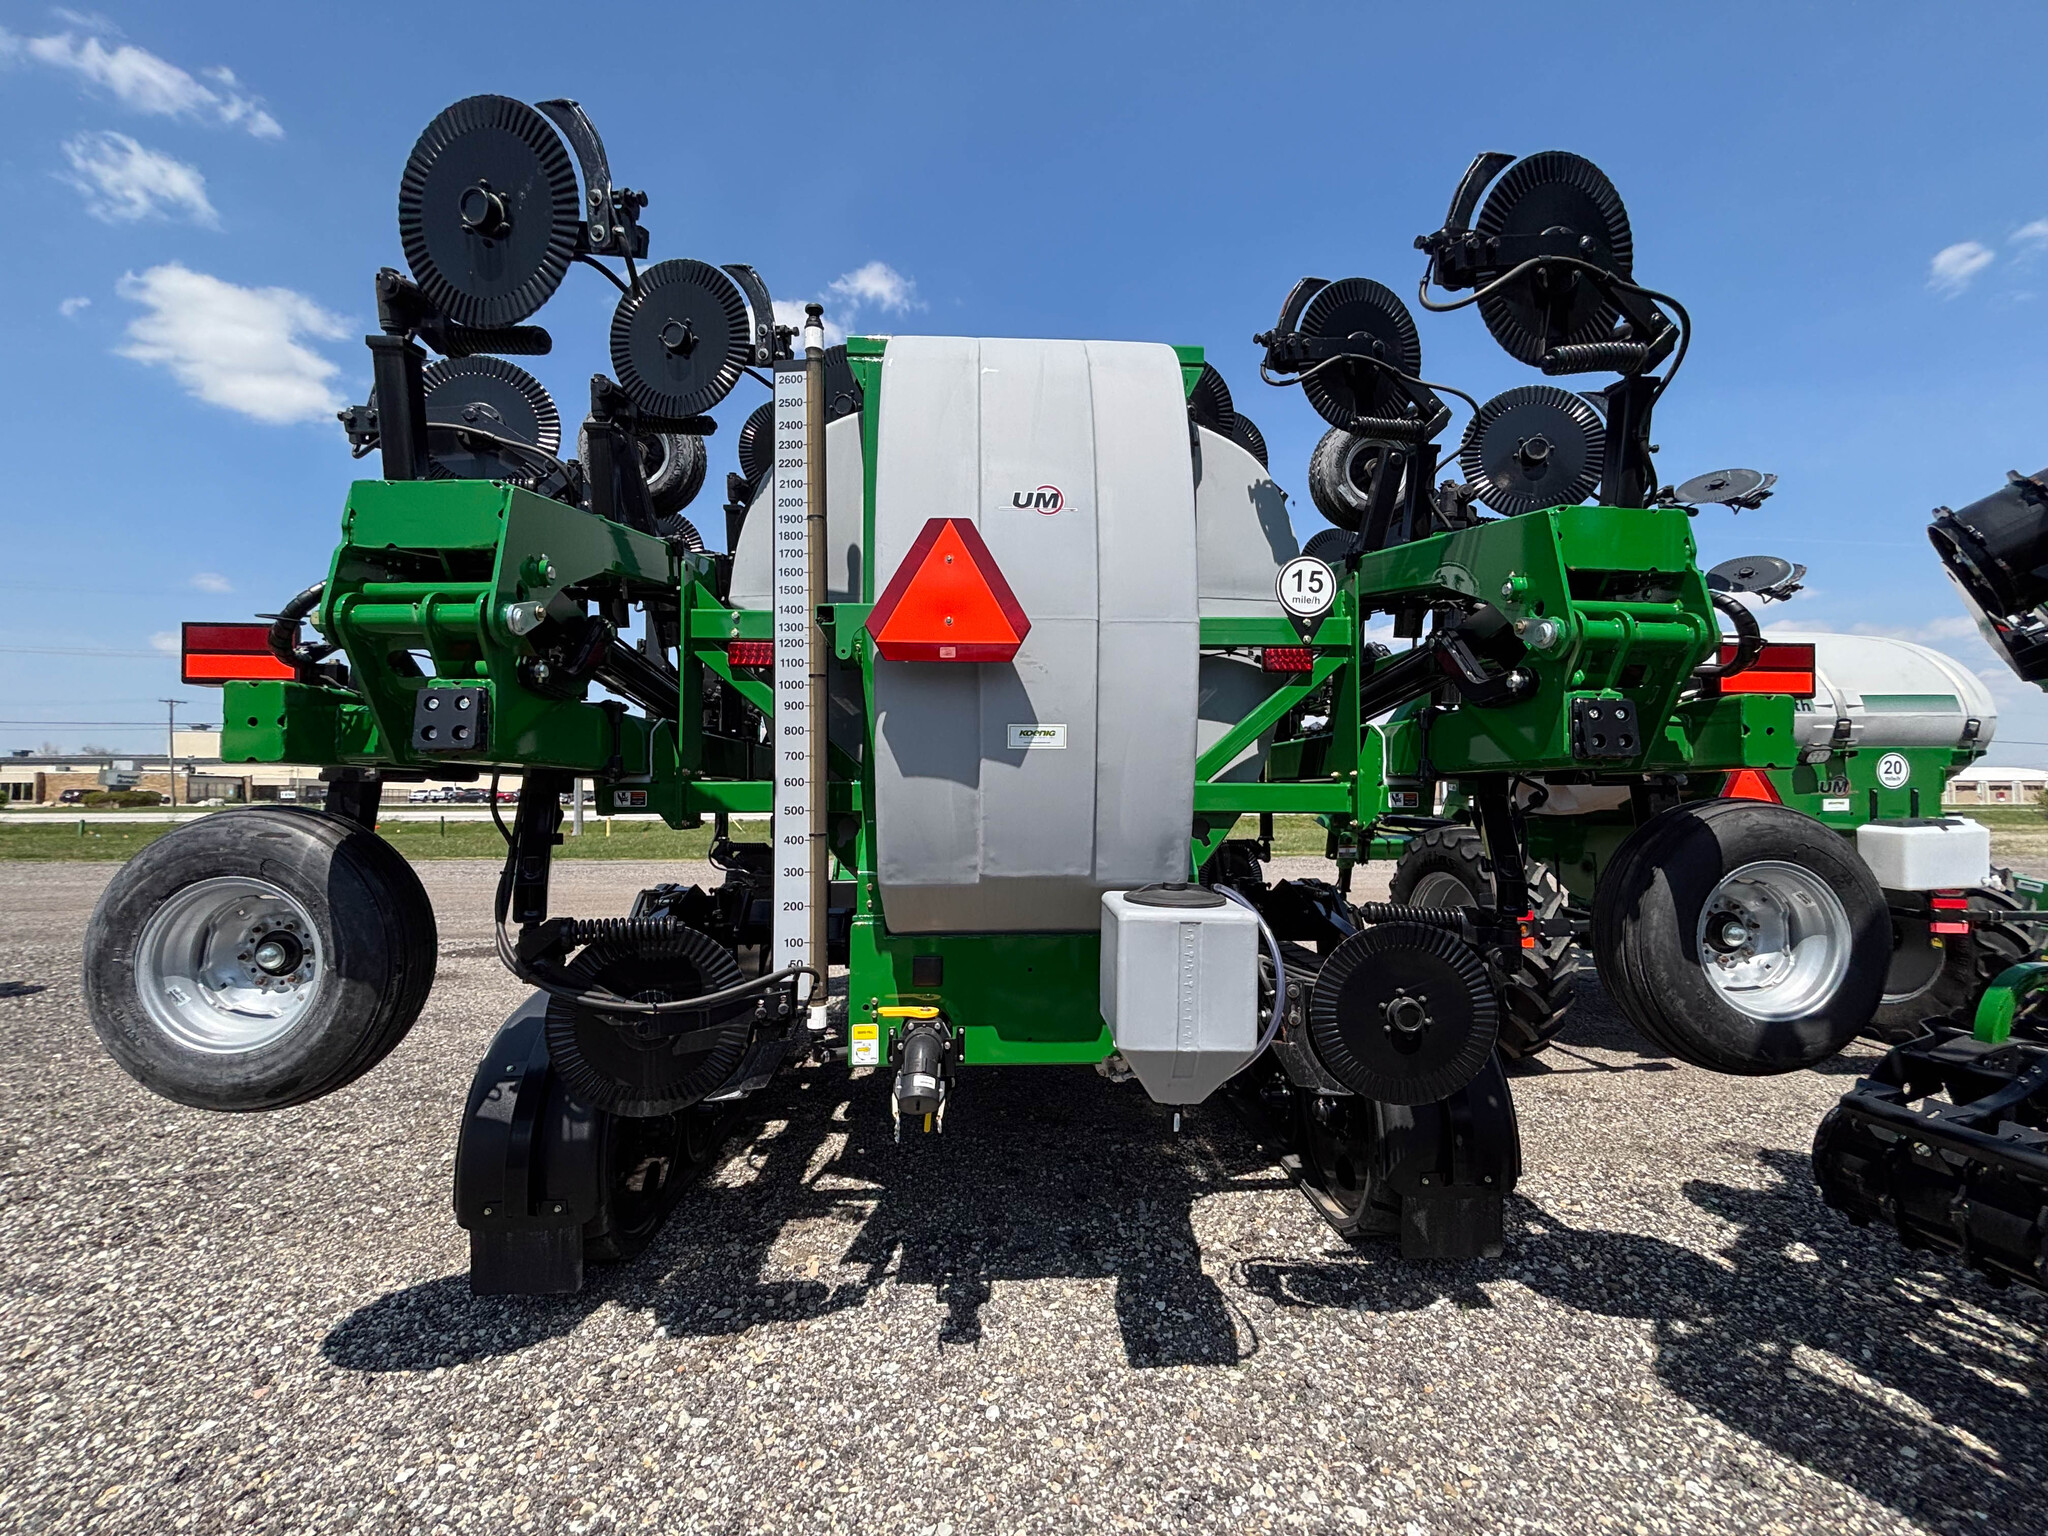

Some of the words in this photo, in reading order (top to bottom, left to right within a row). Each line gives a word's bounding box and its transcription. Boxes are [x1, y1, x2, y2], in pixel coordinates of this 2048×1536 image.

[779, 375, 803, 384] 2600
[779, 398, 803, 407] 2500
[779, 421, 803, 429] 2400
[779, 440, 803, 449] 2300
[779, 459, 803, 468] 2200
[779, 480, 803, 488] 2100
[779, 498, 803, 507] 2000
[1012, 491, 1061, 510] UM
[779, 515, 803, 523] 1900
[779, 532, 803, 540] 1800
[779, 549, 803, 558] 1700
[779, 568, 803, 576] 1600
[1292, 569, 1323, 593] 15
[779, 586, 803, 594] 1500
[1292, 596, 1320, 604] mile/h
[779, 605, 803, 614] 1400
[779, 623, 803, 632] 1300
[779, 639, 804, 647] 1200
[781, 659, 804, 667] 1100
[778, 681, 804, 689] 1000
[784, 701, 804, 710] 900
[784, 726, 804, 735] 800
[784, 752, 804, 760] 700
[1884, 760, 1902, 775] 20
[784, 778, 804, 786] 600
[1820, 780, 1849, 794] UM
[784, 806, 804, 815] 500
[784, 836, 804, 844] 400
[784, 868, 803, 876] 300
[784, 902, 803, 911] 200
[784, 938, 803, 947] 100
